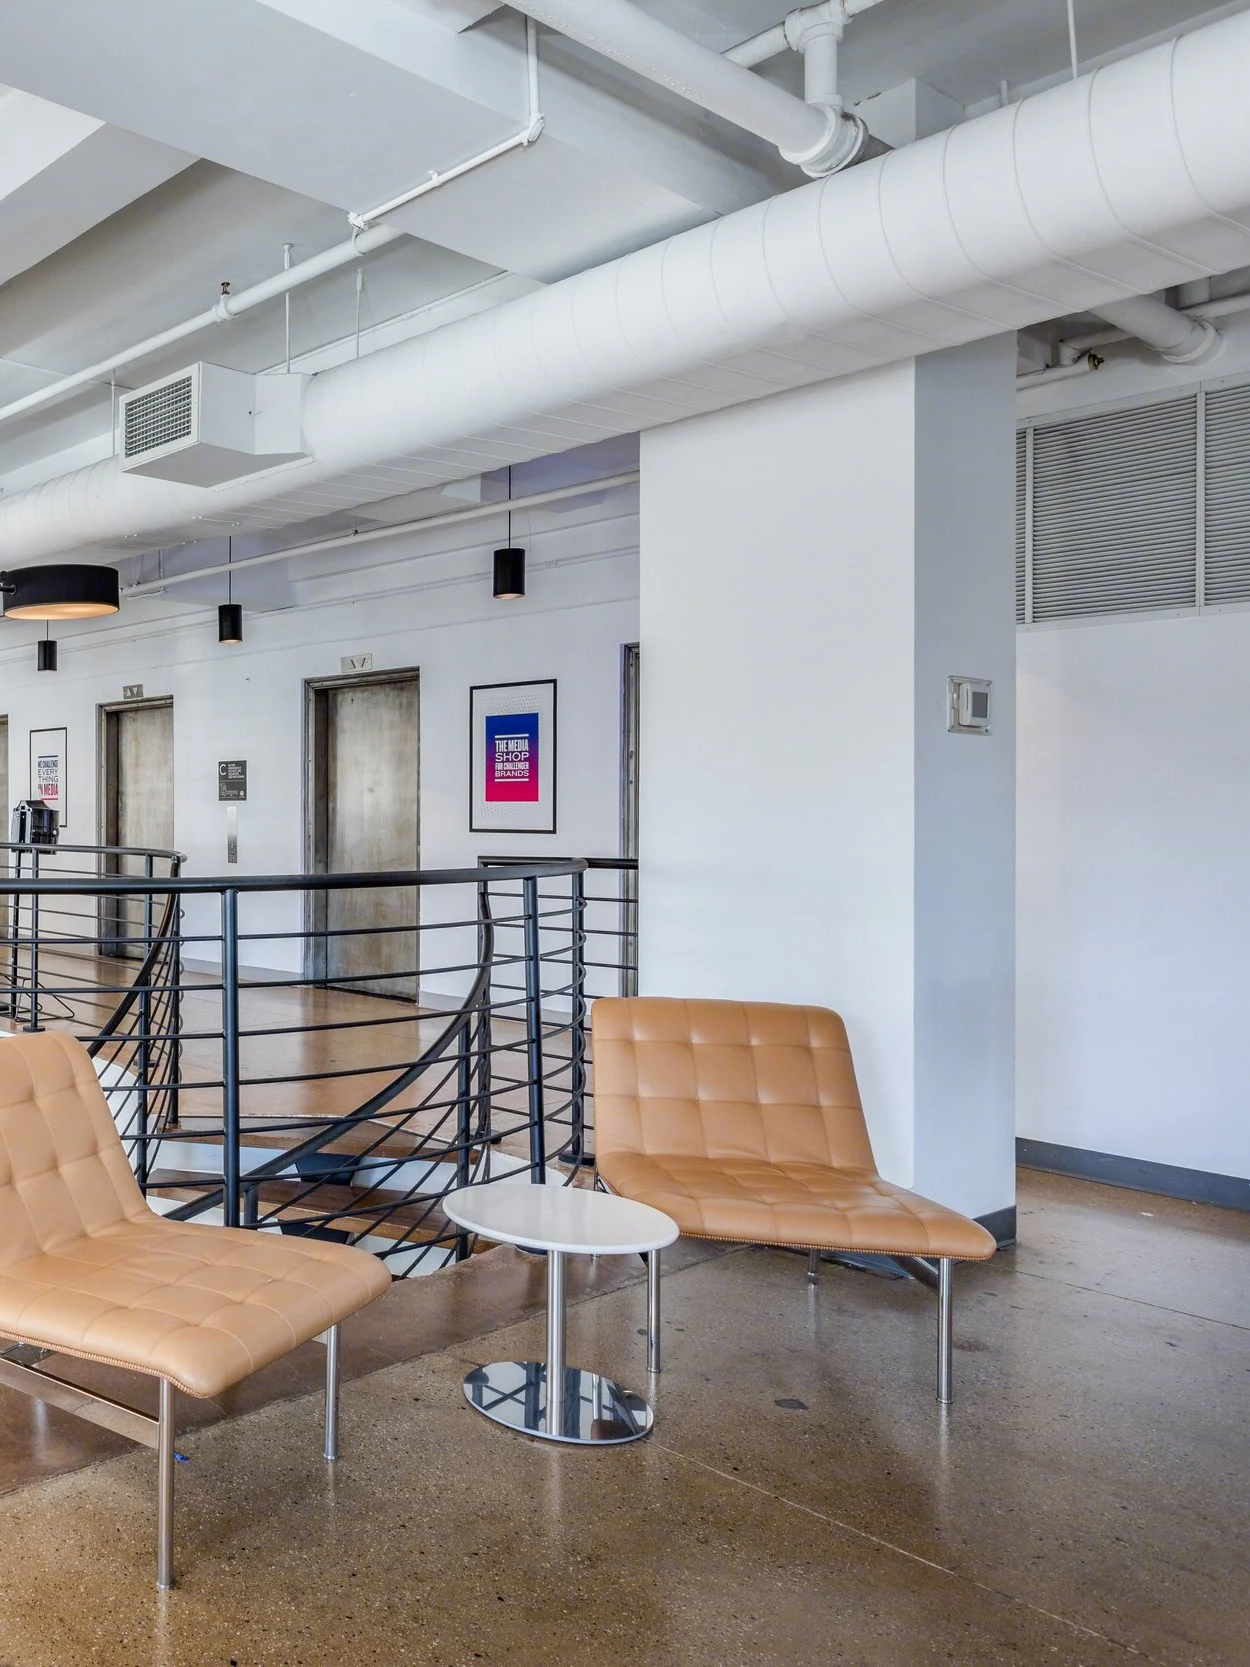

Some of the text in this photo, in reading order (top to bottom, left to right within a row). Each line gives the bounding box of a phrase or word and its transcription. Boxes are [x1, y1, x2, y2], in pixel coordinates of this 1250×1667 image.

[495, 739, 529, 752] THE MEDIA
[495, 752, 529, 762] SHOP
[220, 763, 226, 775] C
[504, 762, 529, 770] CHALLENGER
[44, 783, 58, 795] MEDIA
